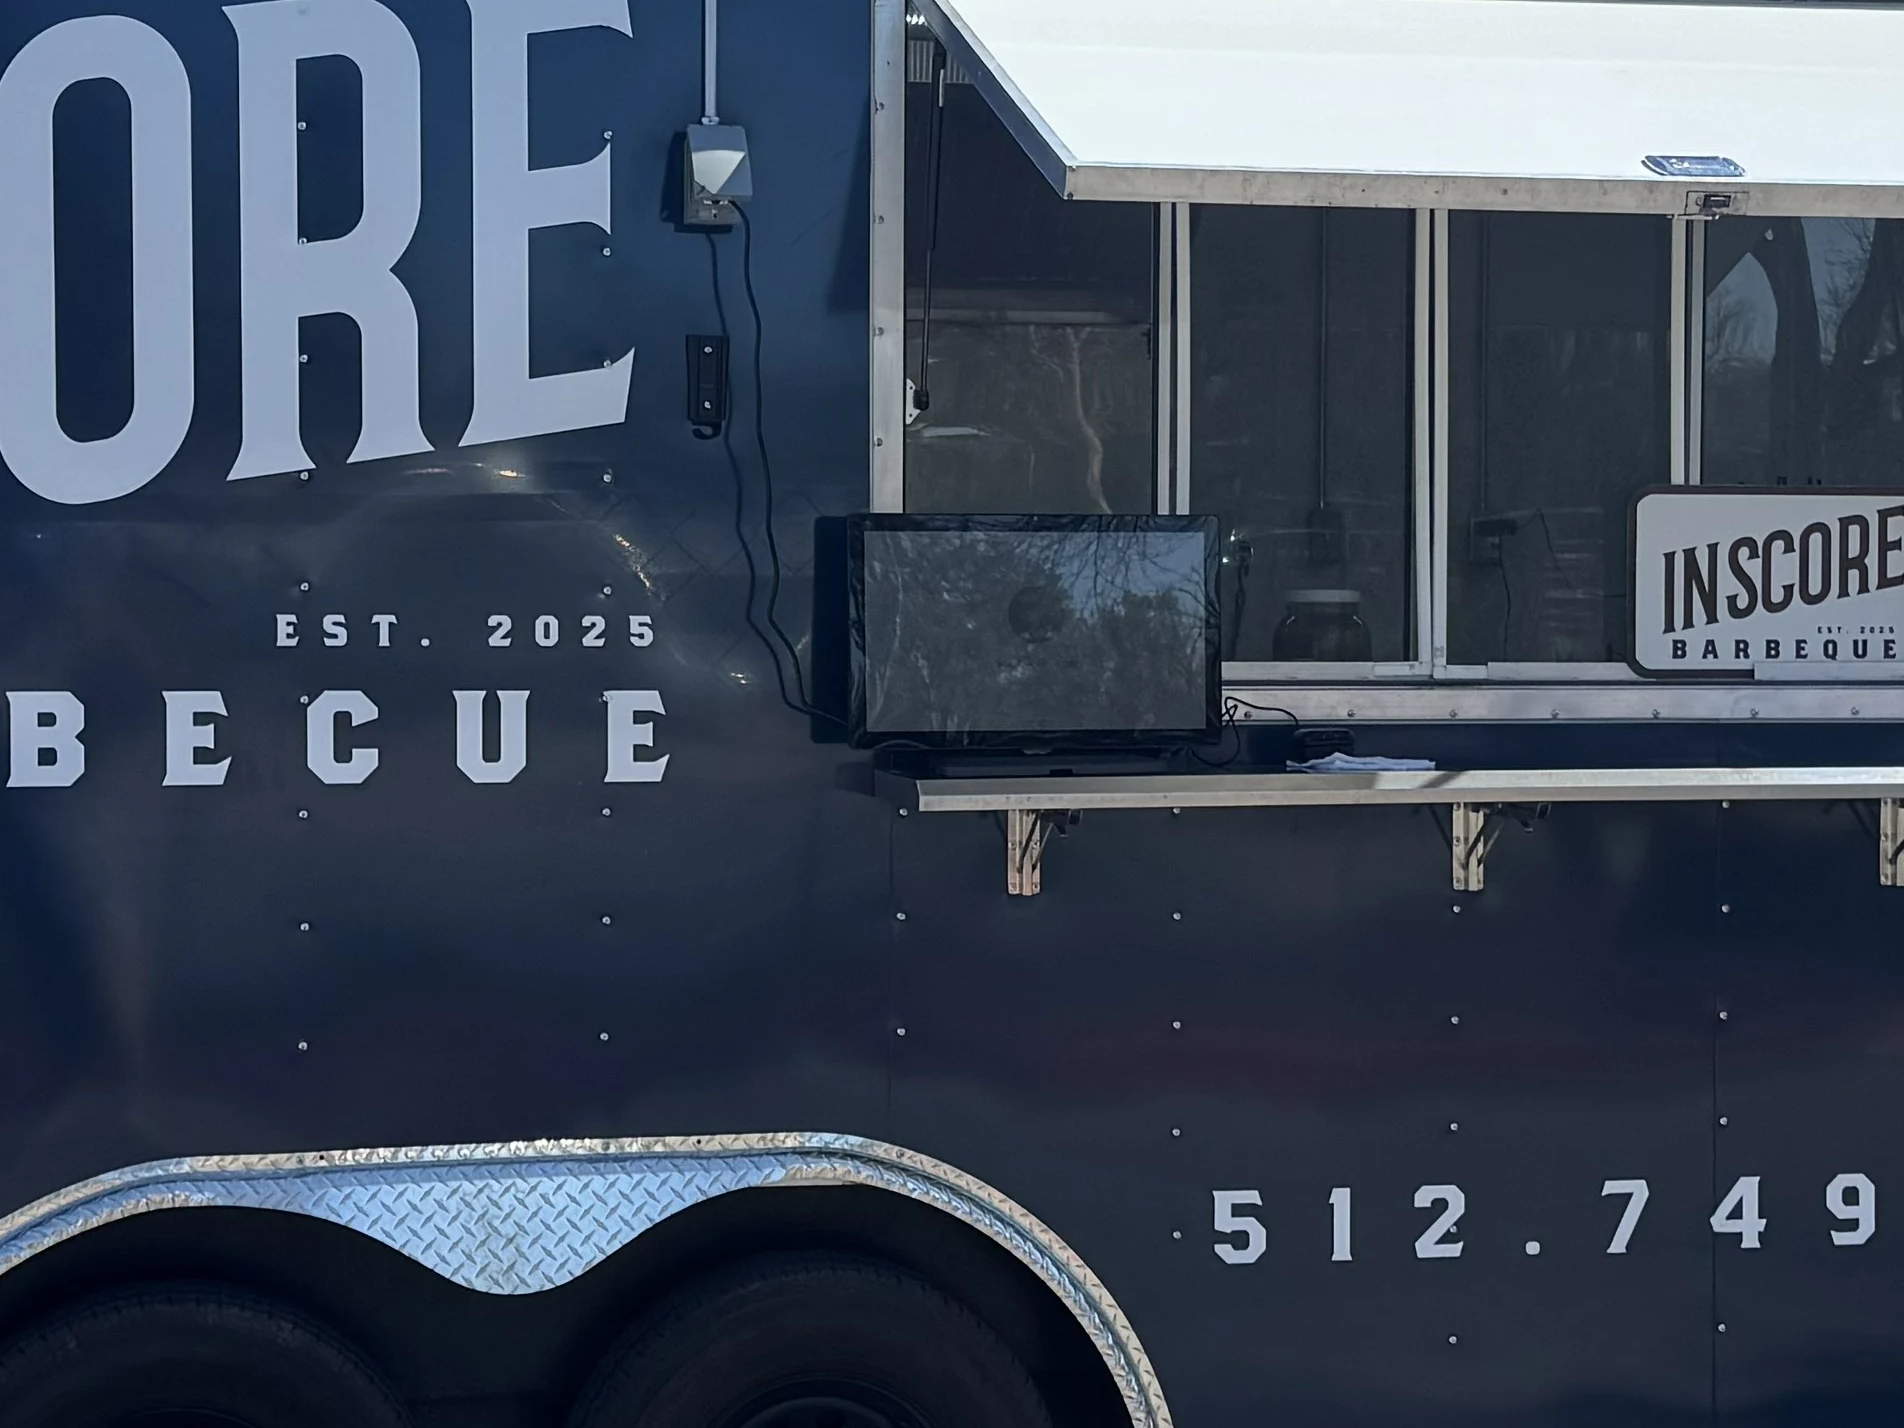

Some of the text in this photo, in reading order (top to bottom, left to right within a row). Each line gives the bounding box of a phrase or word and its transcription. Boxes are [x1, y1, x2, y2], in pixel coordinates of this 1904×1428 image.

[275, 613, 655, 647] EST. 2025
[1671, 639, 1897, 661] BARBEQUE
